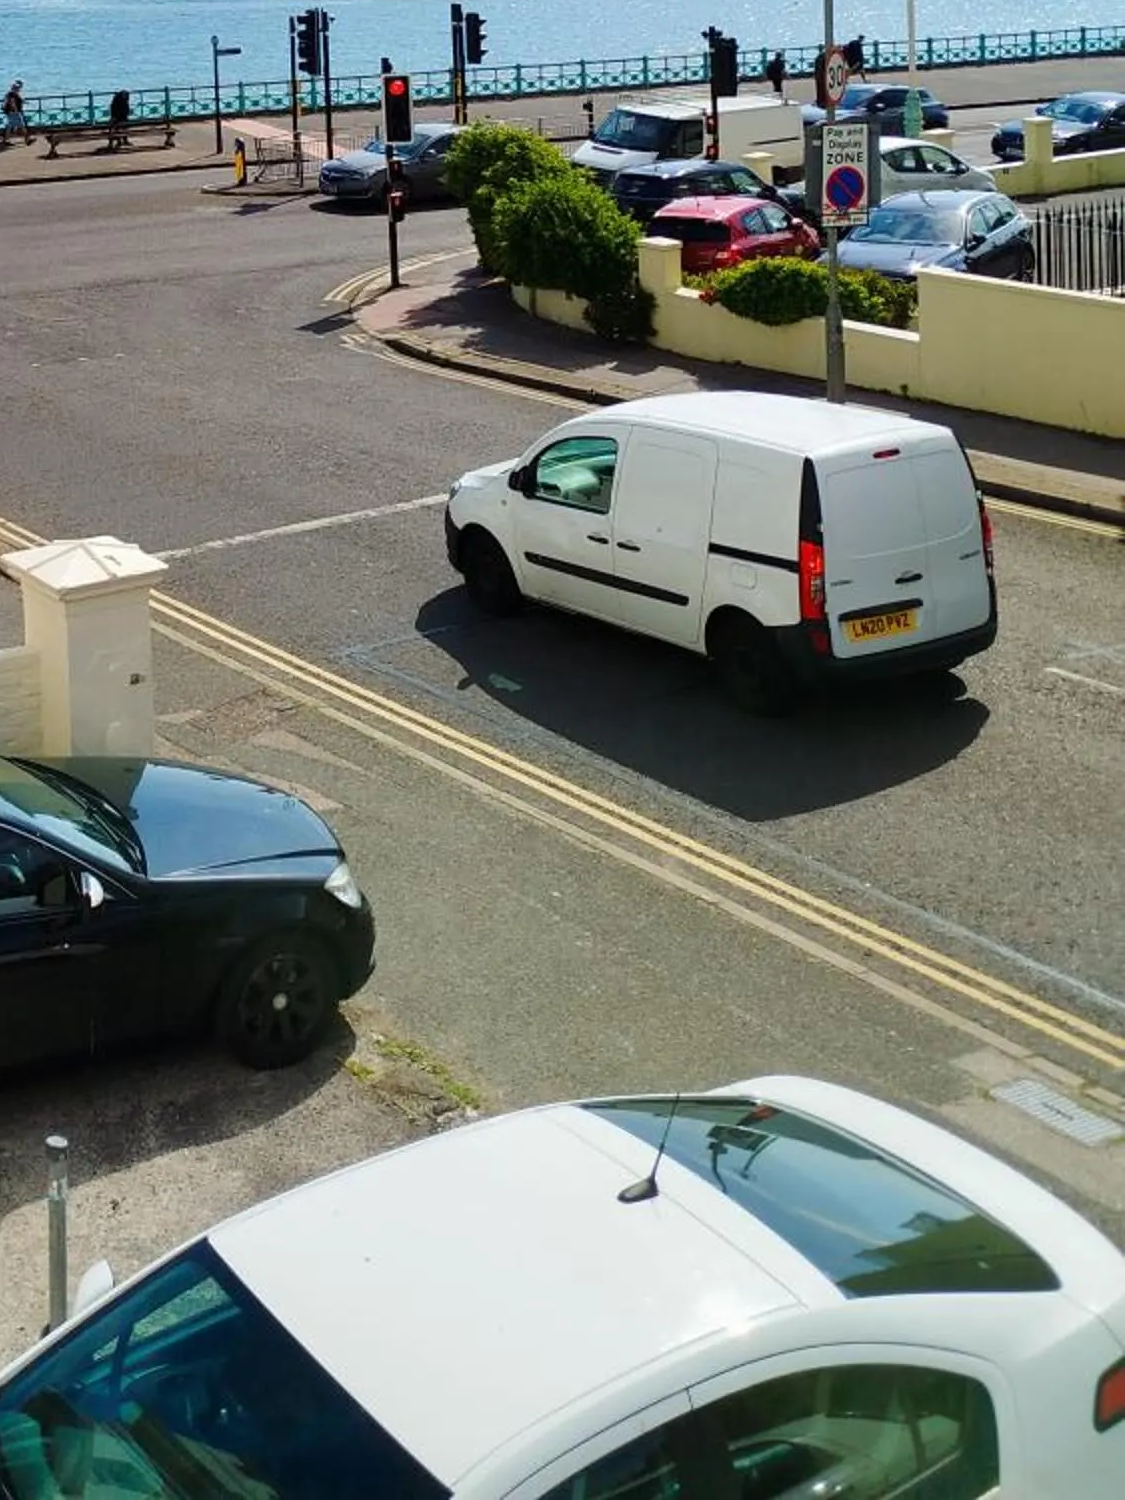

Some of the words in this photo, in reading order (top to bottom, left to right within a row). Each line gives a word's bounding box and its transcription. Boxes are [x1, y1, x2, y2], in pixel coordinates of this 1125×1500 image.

[829, 65, 844, 89] 30
[827, 128, 844, 138] Pay
[847, 127, 863, 136] and
[829, 139, 862, 150] Display
[826, 152, 864, 165] ZONE
